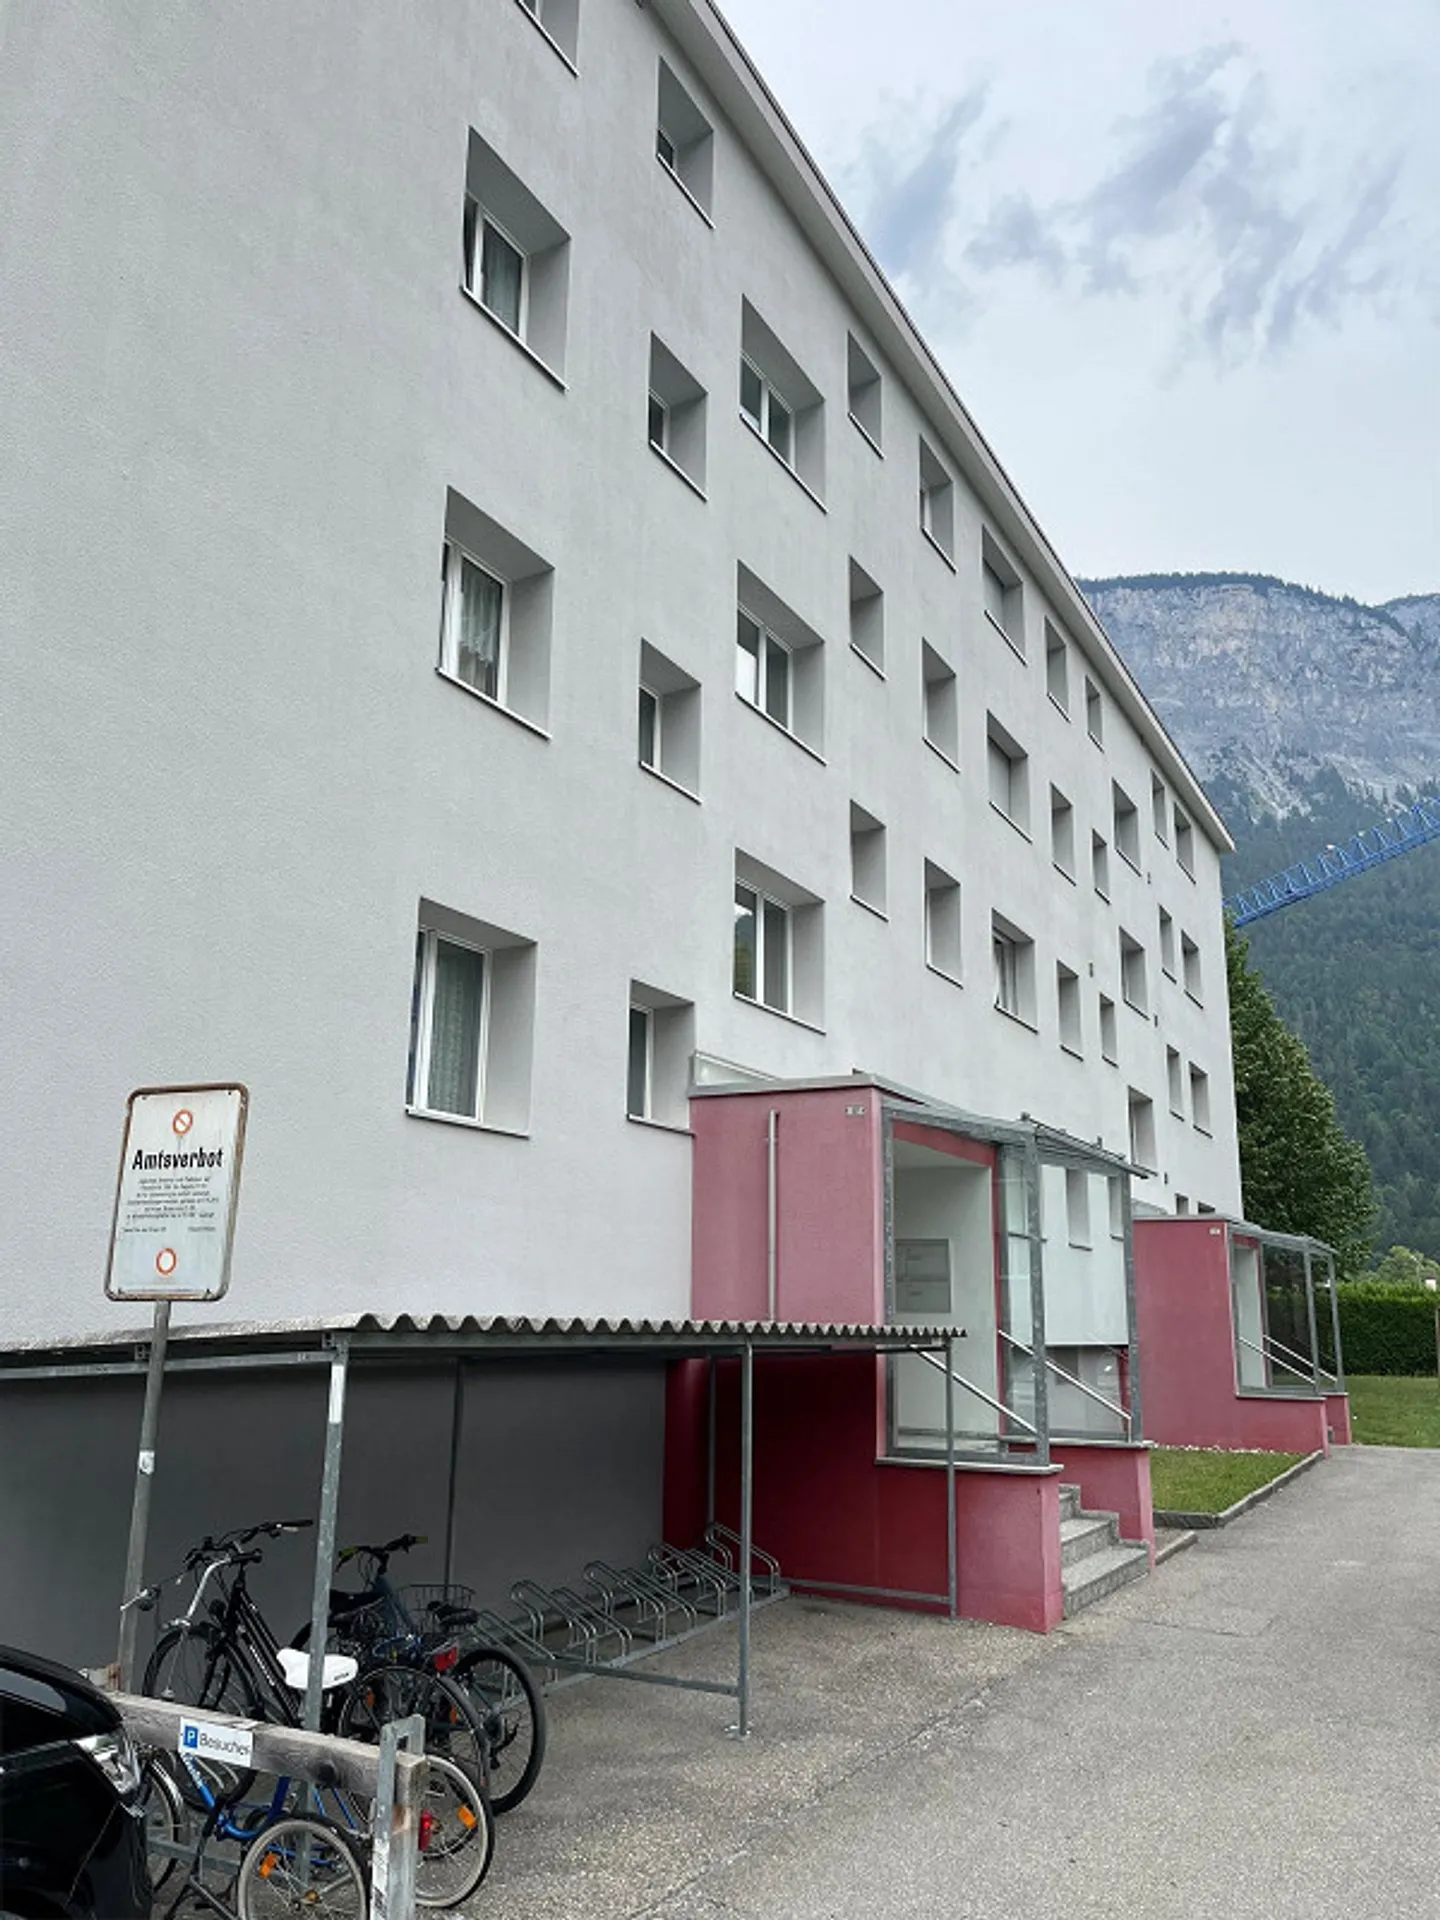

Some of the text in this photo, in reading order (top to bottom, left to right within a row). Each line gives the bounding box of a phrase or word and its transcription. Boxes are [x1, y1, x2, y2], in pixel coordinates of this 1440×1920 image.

[132, 1147, 224, 1170] Amtsverbot
[187, 1730, 250, 1755] P Besucher
